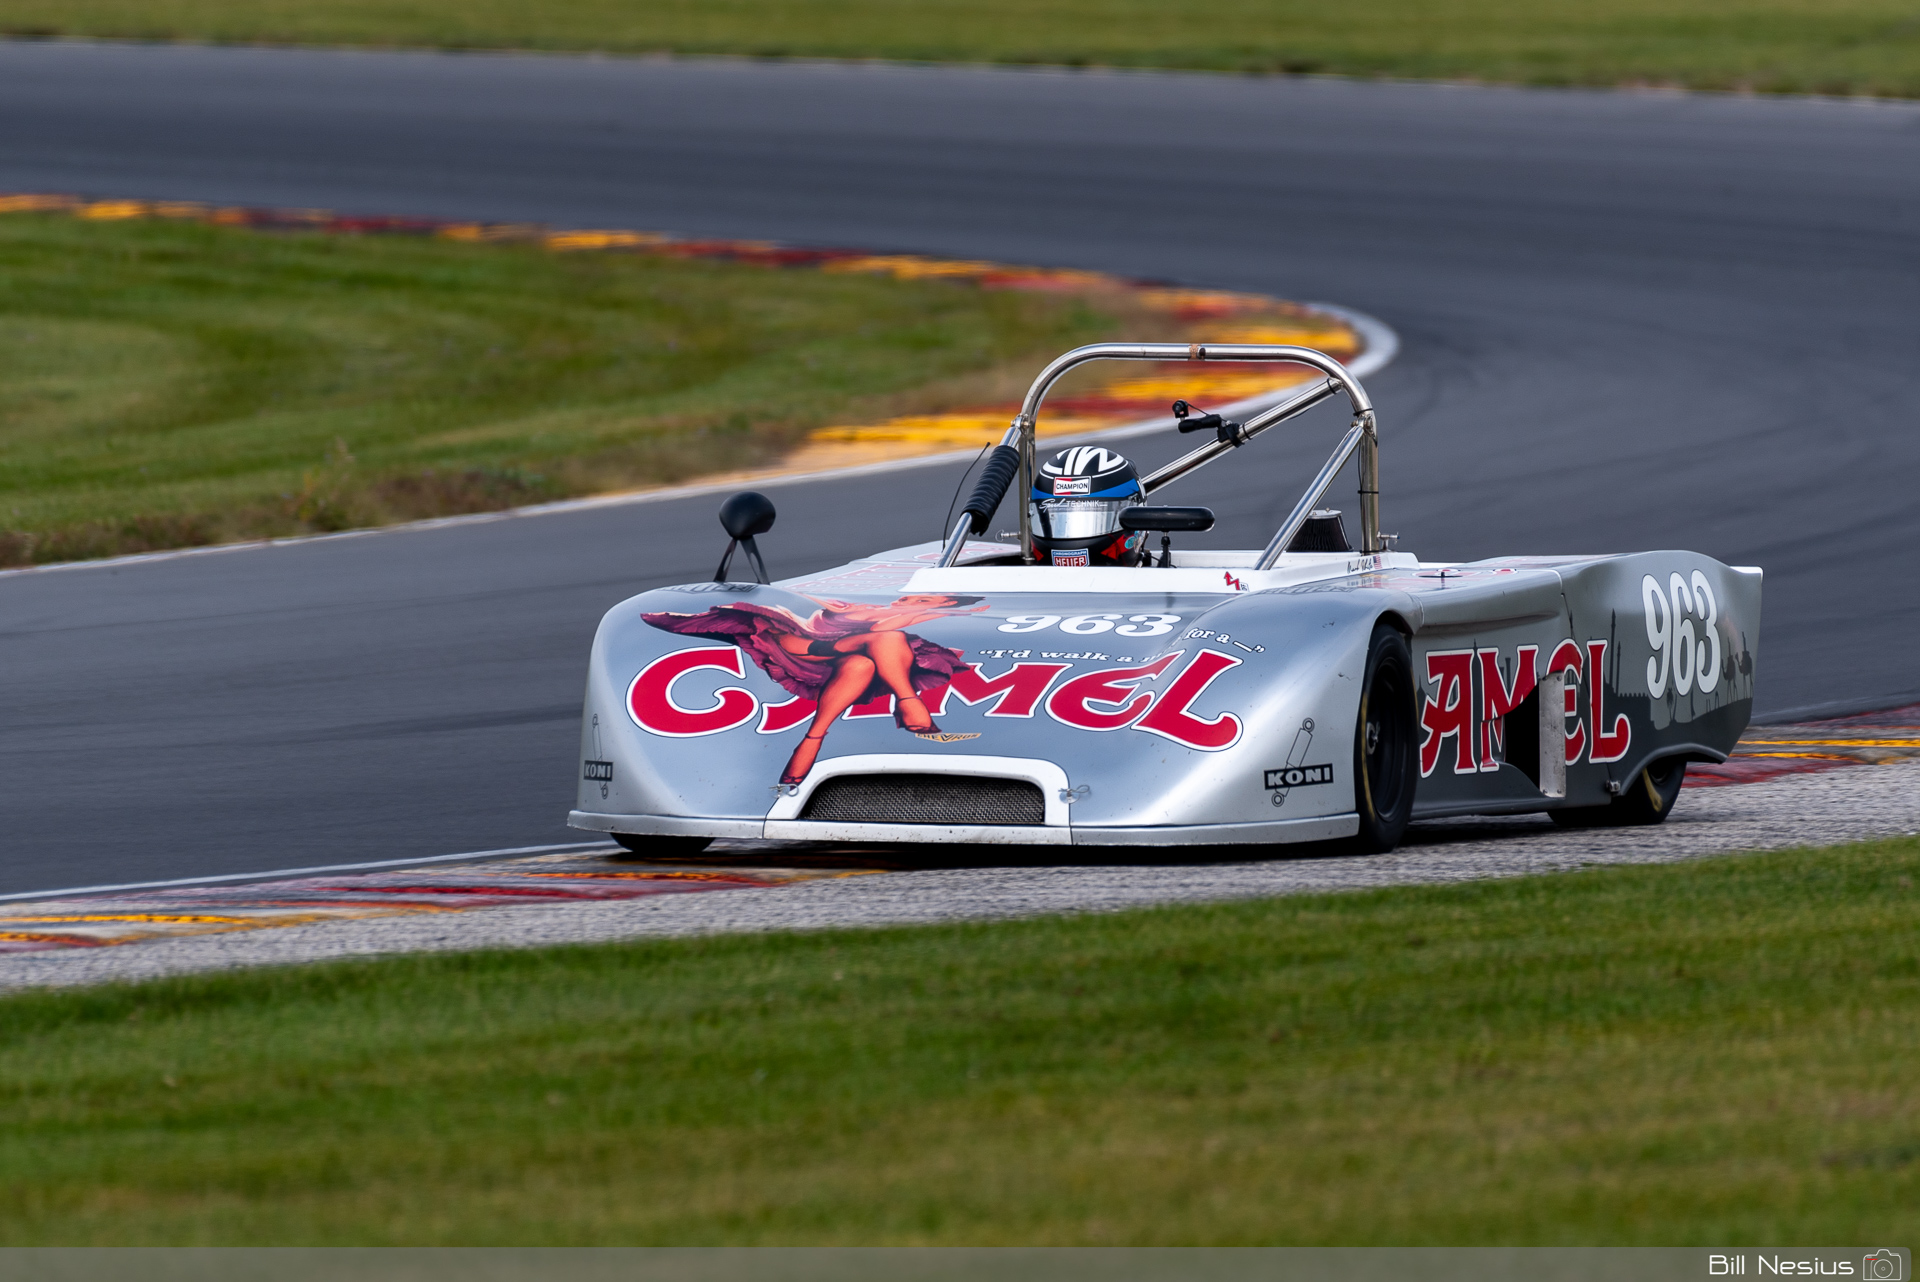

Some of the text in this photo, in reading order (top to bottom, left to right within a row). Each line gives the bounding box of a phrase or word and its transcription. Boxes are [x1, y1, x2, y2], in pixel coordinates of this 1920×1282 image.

[997, 613, 1182, 637] 963
[1642, 569, 1721, 699] 963
[1040, 651, 1112, 662] walk
[1116, 655, 1134, 663] a
[1183, 628, 1215, 641] for
[1216, 633, 1231, 644] a
[584, 763, 612, 779] KONI
[1267, 766, 1331, 787] KONI
